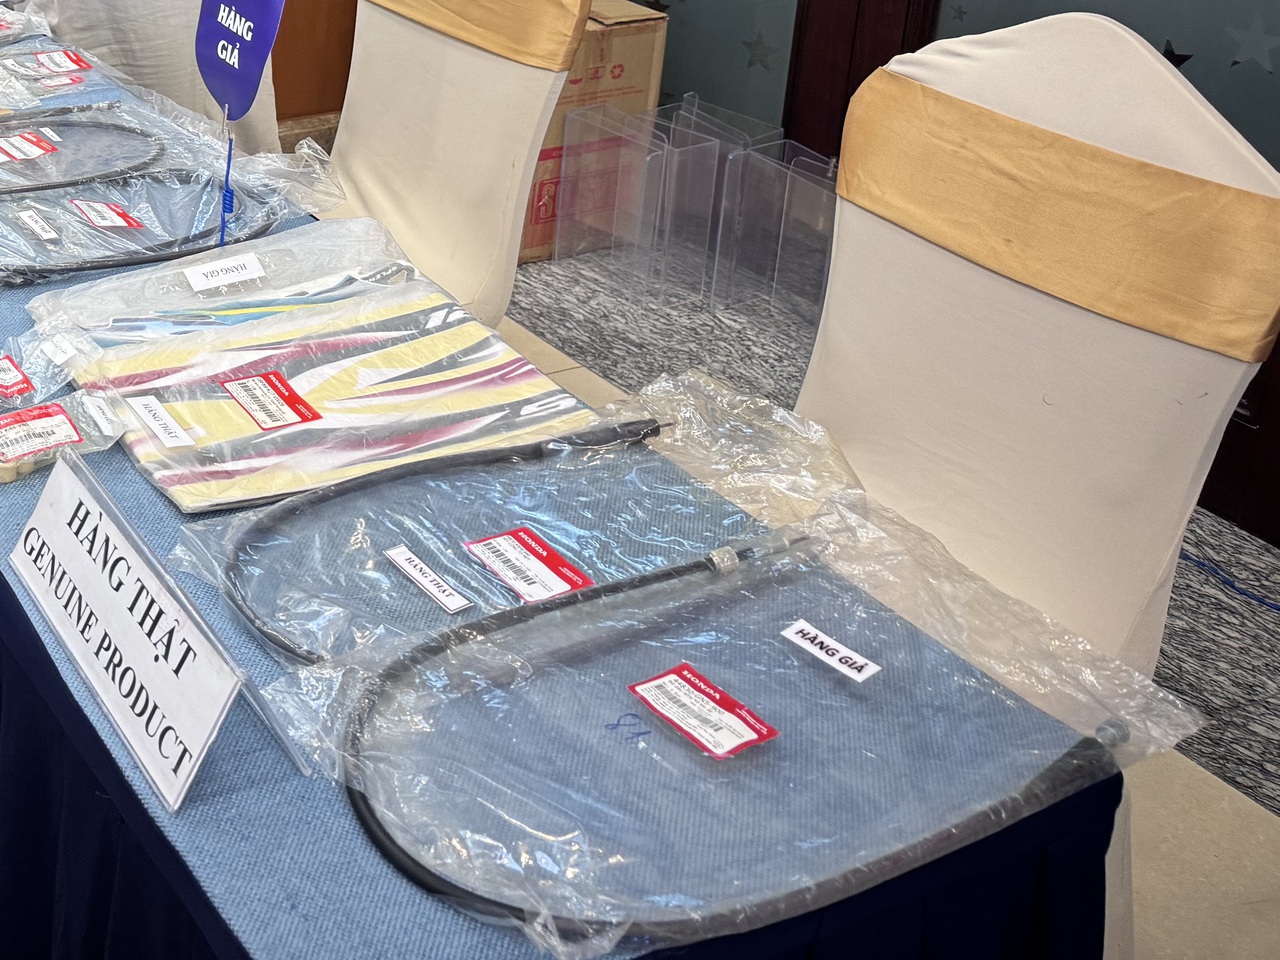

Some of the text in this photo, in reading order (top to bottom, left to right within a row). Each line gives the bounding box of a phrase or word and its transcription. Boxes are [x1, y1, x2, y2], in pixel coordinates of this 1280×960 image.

[217, 3, 254, 41] HÀNG
[217, 40, 239, 69] GIẢ
[220, 262, 247, 276] HÀNG
[268, 374, 290, 397] HONDA
[142, 403, 179, 439] HÀNG THẬT
[518, 531, 548, 557] HONDA
[66, 497, 197, 680] HÀNG THẬT
[405, 556, 454, 597] HÀNG THẬT
[23, 526, 193, 778] GENUINE PRODUCT
[794, 628, 869, 673] HÀNG GIẢ
[682, 669, 720, 700] HONDA
